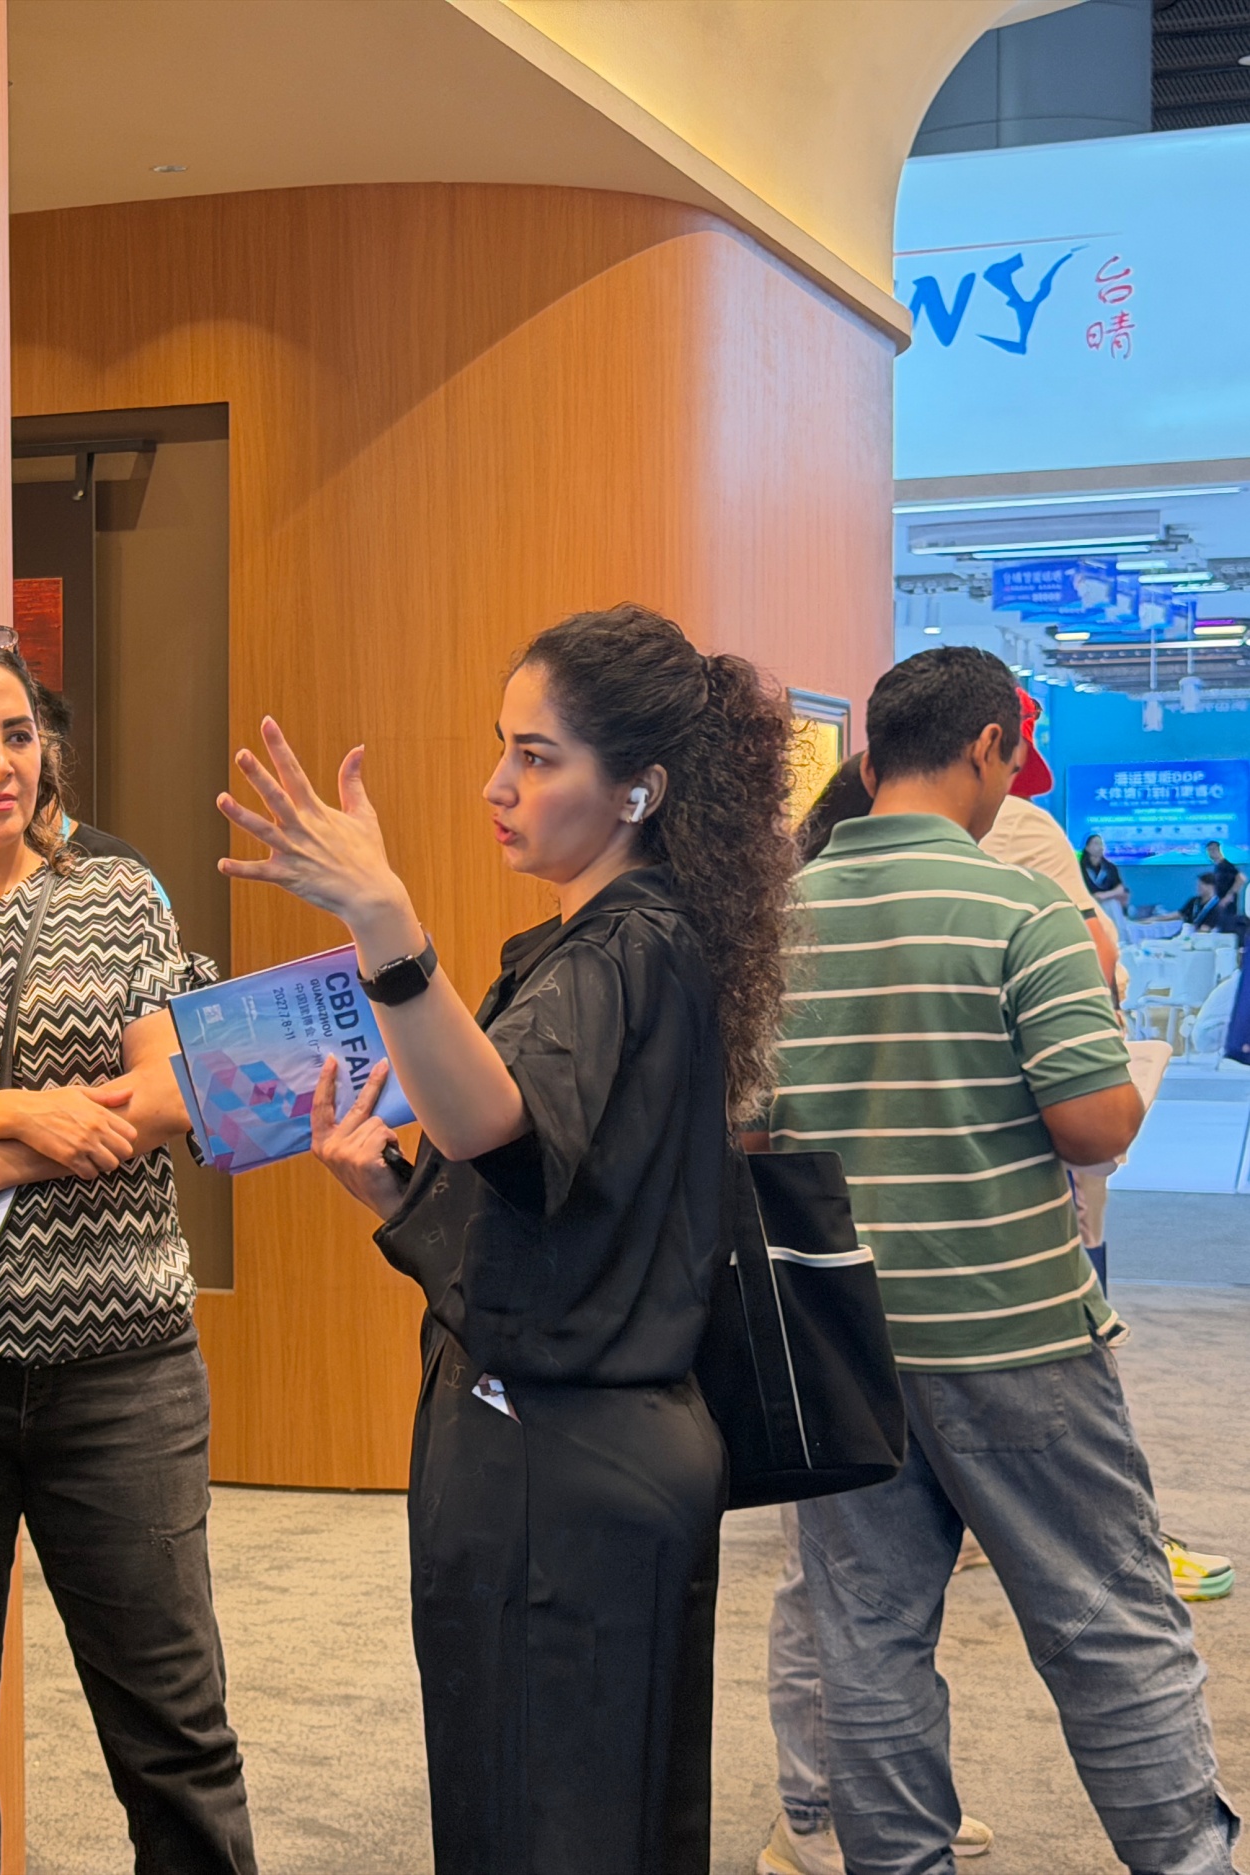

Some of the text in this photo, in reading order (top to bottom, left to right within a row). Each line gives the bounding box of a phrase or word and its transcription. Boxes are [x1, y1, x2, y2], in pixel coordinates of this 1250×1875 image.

[893, 243, 1090, 356] NY
[310, 978, 333, 1038] GUANGZHOU
[325, 971, 370, 1100] CBD FAI
